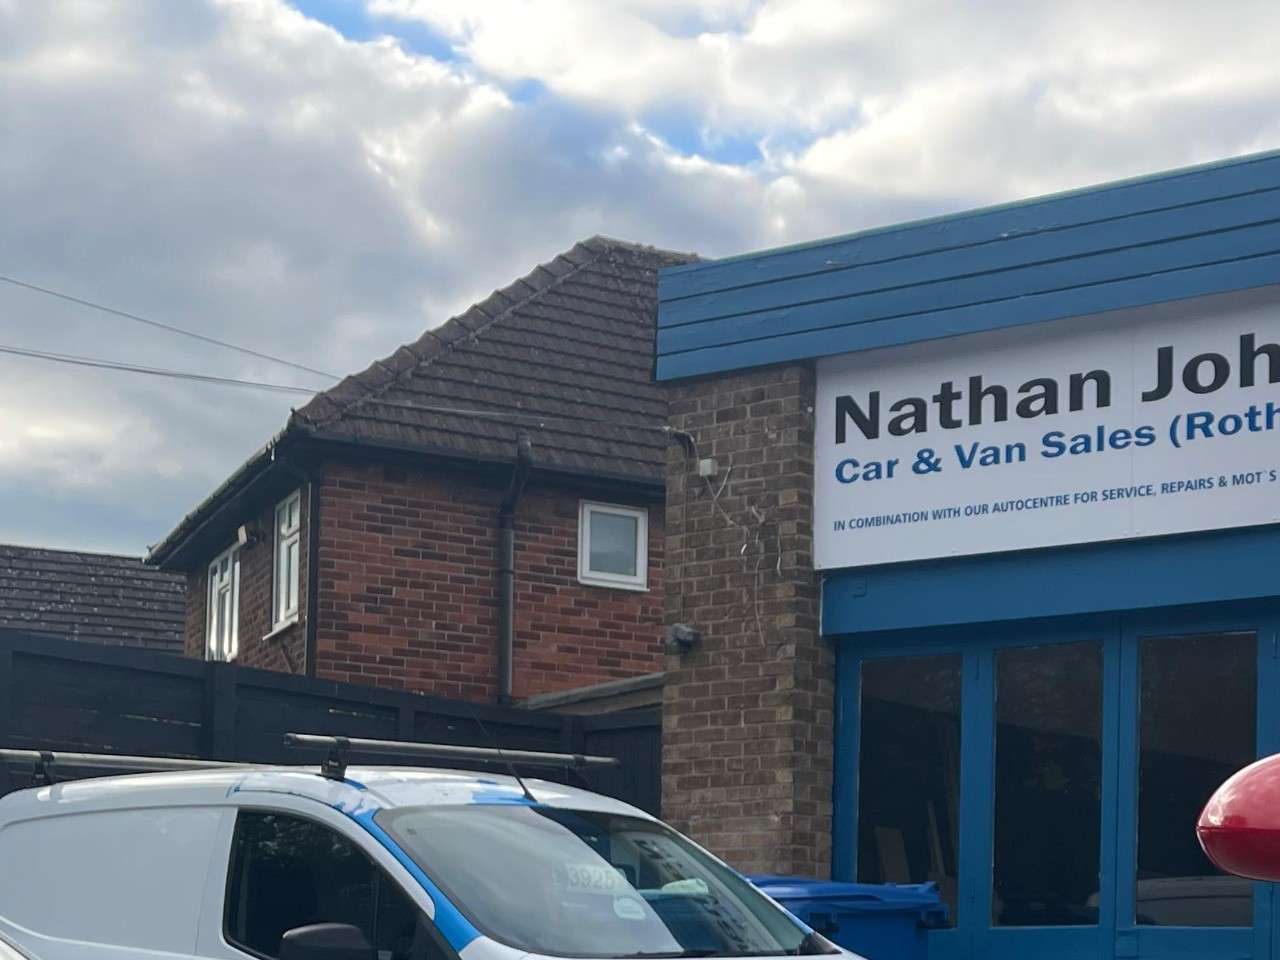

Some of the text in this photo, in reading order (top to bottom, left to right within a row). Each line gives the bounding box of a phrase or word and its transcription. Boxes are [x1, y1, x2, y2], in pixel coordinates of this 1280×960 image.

[835, 365, 1112, 444] Nathan
[835, 458, 900, 484] Car
[911, 448, 943, 475] &
[953, 440, 1027, 469] Van
[1041, 424, 1156, 460] Sales
[833, 520, 846, 532] IN
[848, 511, 929, 530] COMBINATION
[932, 507, 961, 521] WITH
[964, 504, 989, 517] OUR
[991, 494, 1071, 513] AUTOCENTRE
[1073, 491, 1098, 504] FOR
[1101, 484, 1157, 501] SERVICE,
[1161, 477, 1214, 494] REPAIRS
[1217, 475, 1228, 488] &
